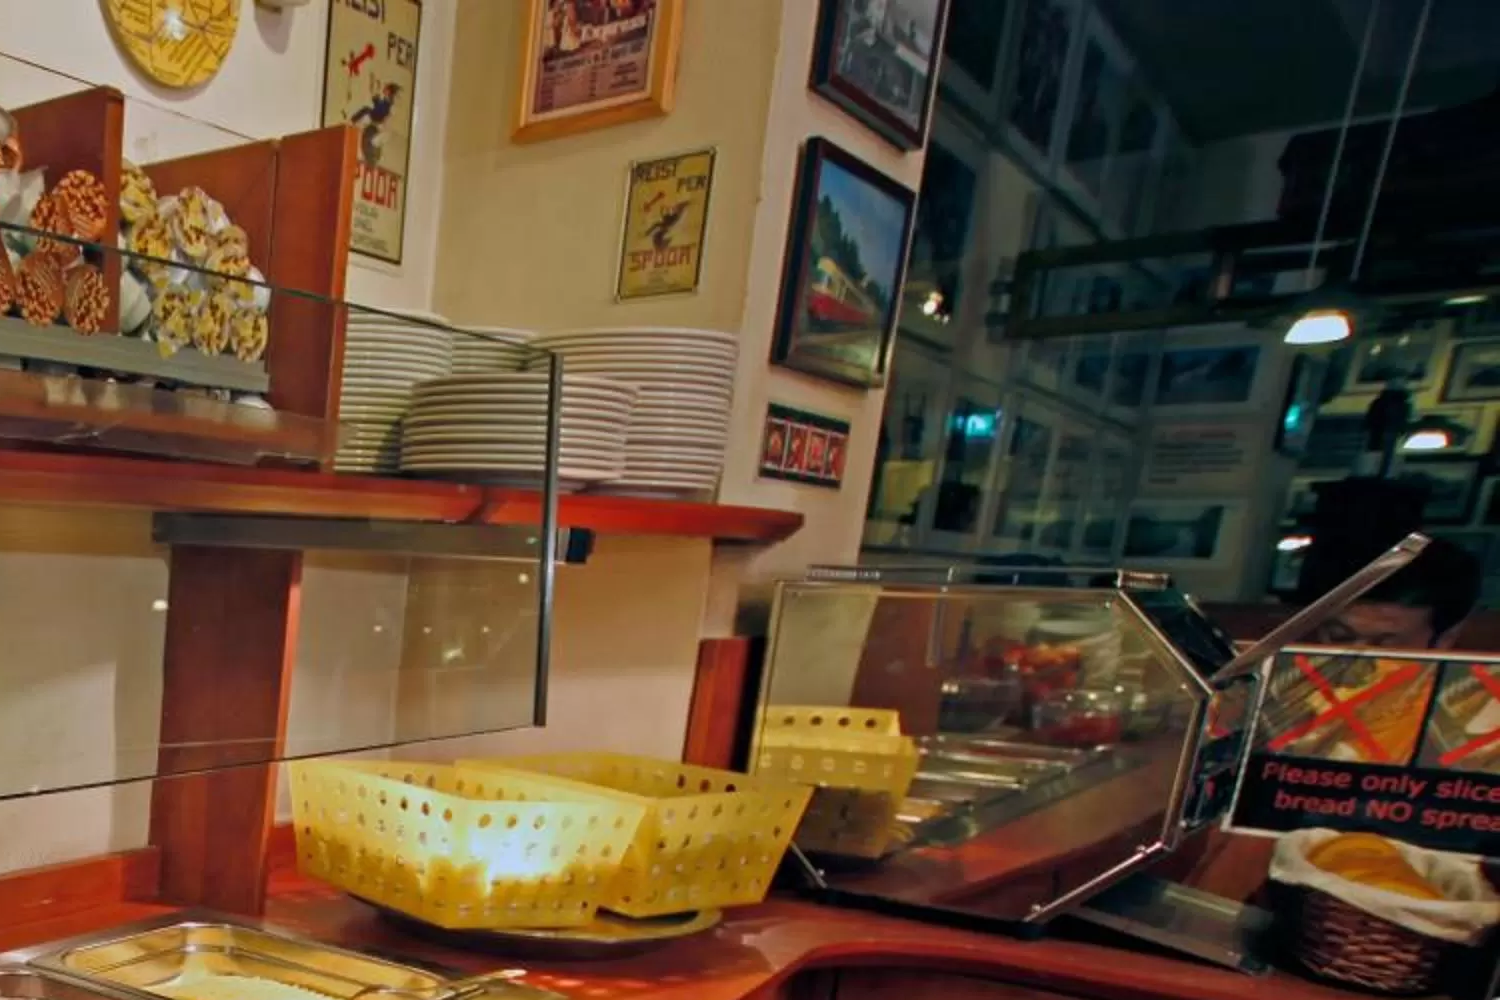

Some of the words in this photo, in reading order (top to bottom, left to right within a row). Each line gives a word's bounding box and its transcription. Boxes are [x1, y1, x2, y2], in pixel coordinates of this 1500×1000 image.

[355, 160, 402, 210] POOR
[628, 243, 697, 272] SPOOR
[1262, 761, 1352, 789] Please
[1361, 775, 1428, 799] only
[1435, 777, 1500, 803] slice
[1274, 790, 1356, 817] bread
[1366, 799, 1413, 823] NO
[1421, 807, 1500, 832] sprea
